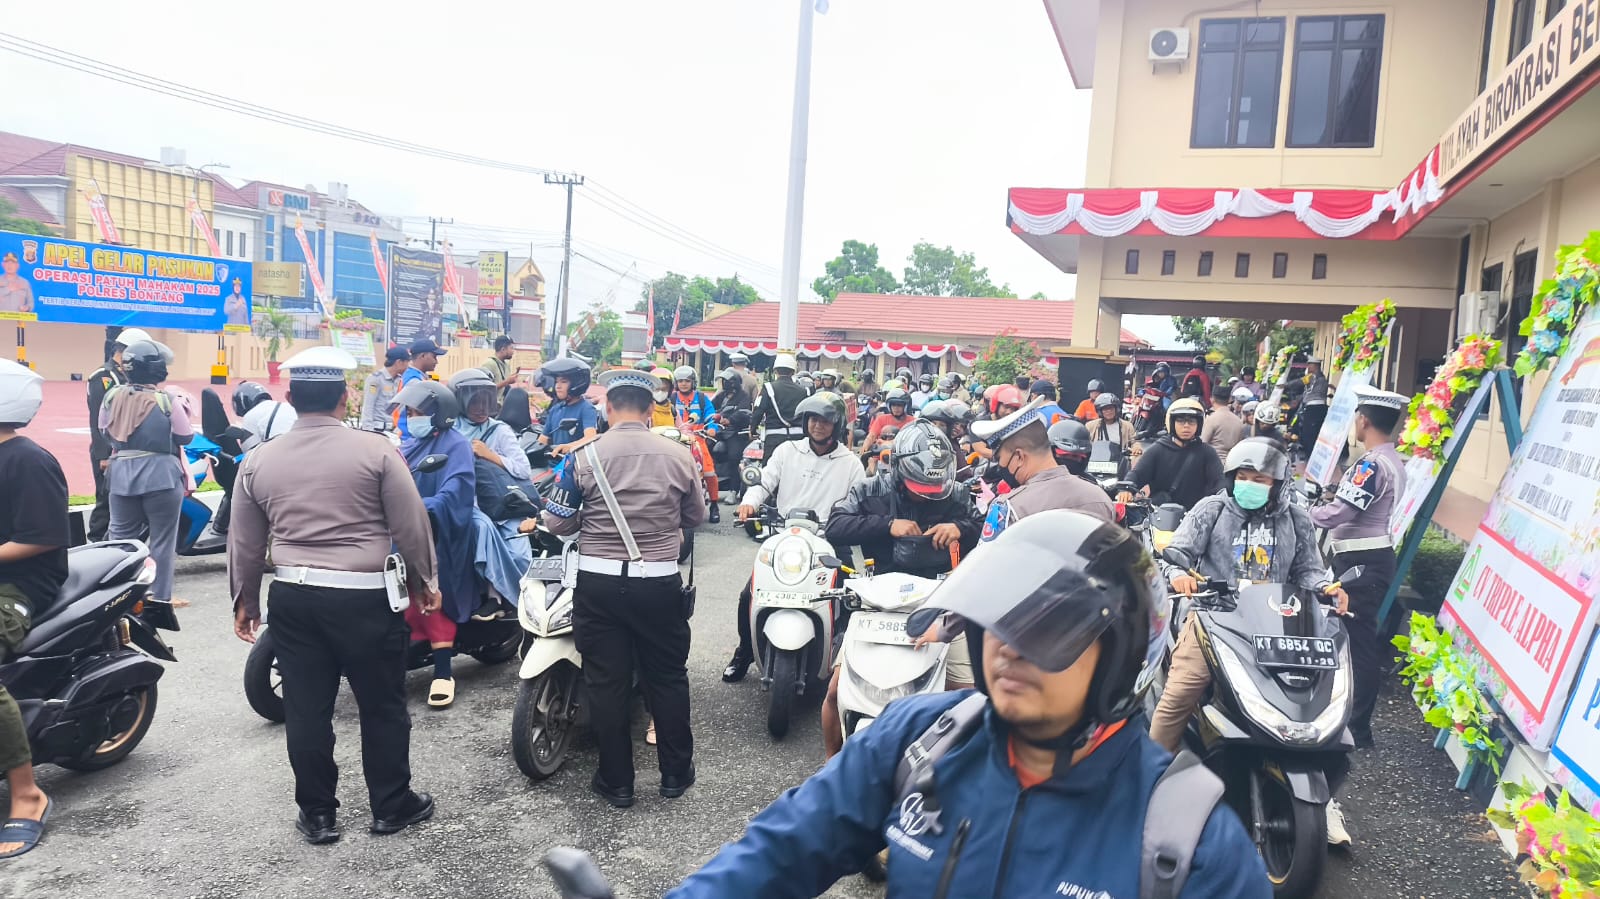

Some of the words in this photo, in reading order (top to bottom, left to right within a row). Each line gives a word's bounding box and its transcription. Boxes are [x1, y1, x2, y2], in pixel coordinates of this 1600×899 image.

[1440, 106, 1480, 178] WILAYAH
[1484, 23, 1562, 141] BIROKRASI
[1569, 0, 1600, 66] BE
[284, 193, 309, 210] BNI
[43, 242, 90, 269] APEL
[92, 248, 144, 276] GELAR
[147, 255, 215, 282] PASUKAN
[34, 269, 92, 284] OPERASI
[95, 275, 135, 289] PATUH
[138, 279, 195, 293] MAHAKAM
[196, 284, 220, 296] 2025
[78, 285, 127, 299] POLRES
[129, 289, 184, 303] BONTANG
[531, 559, 545, 568] KT
[857, 618, 872, 629] KT
[1472, 565, 1493, 600] CV
[1483, 573, 1526, 635] TRIPLE
[1513, 603, 1563, 674] ALPHA
[1256, 638, 1272, 650] KT
